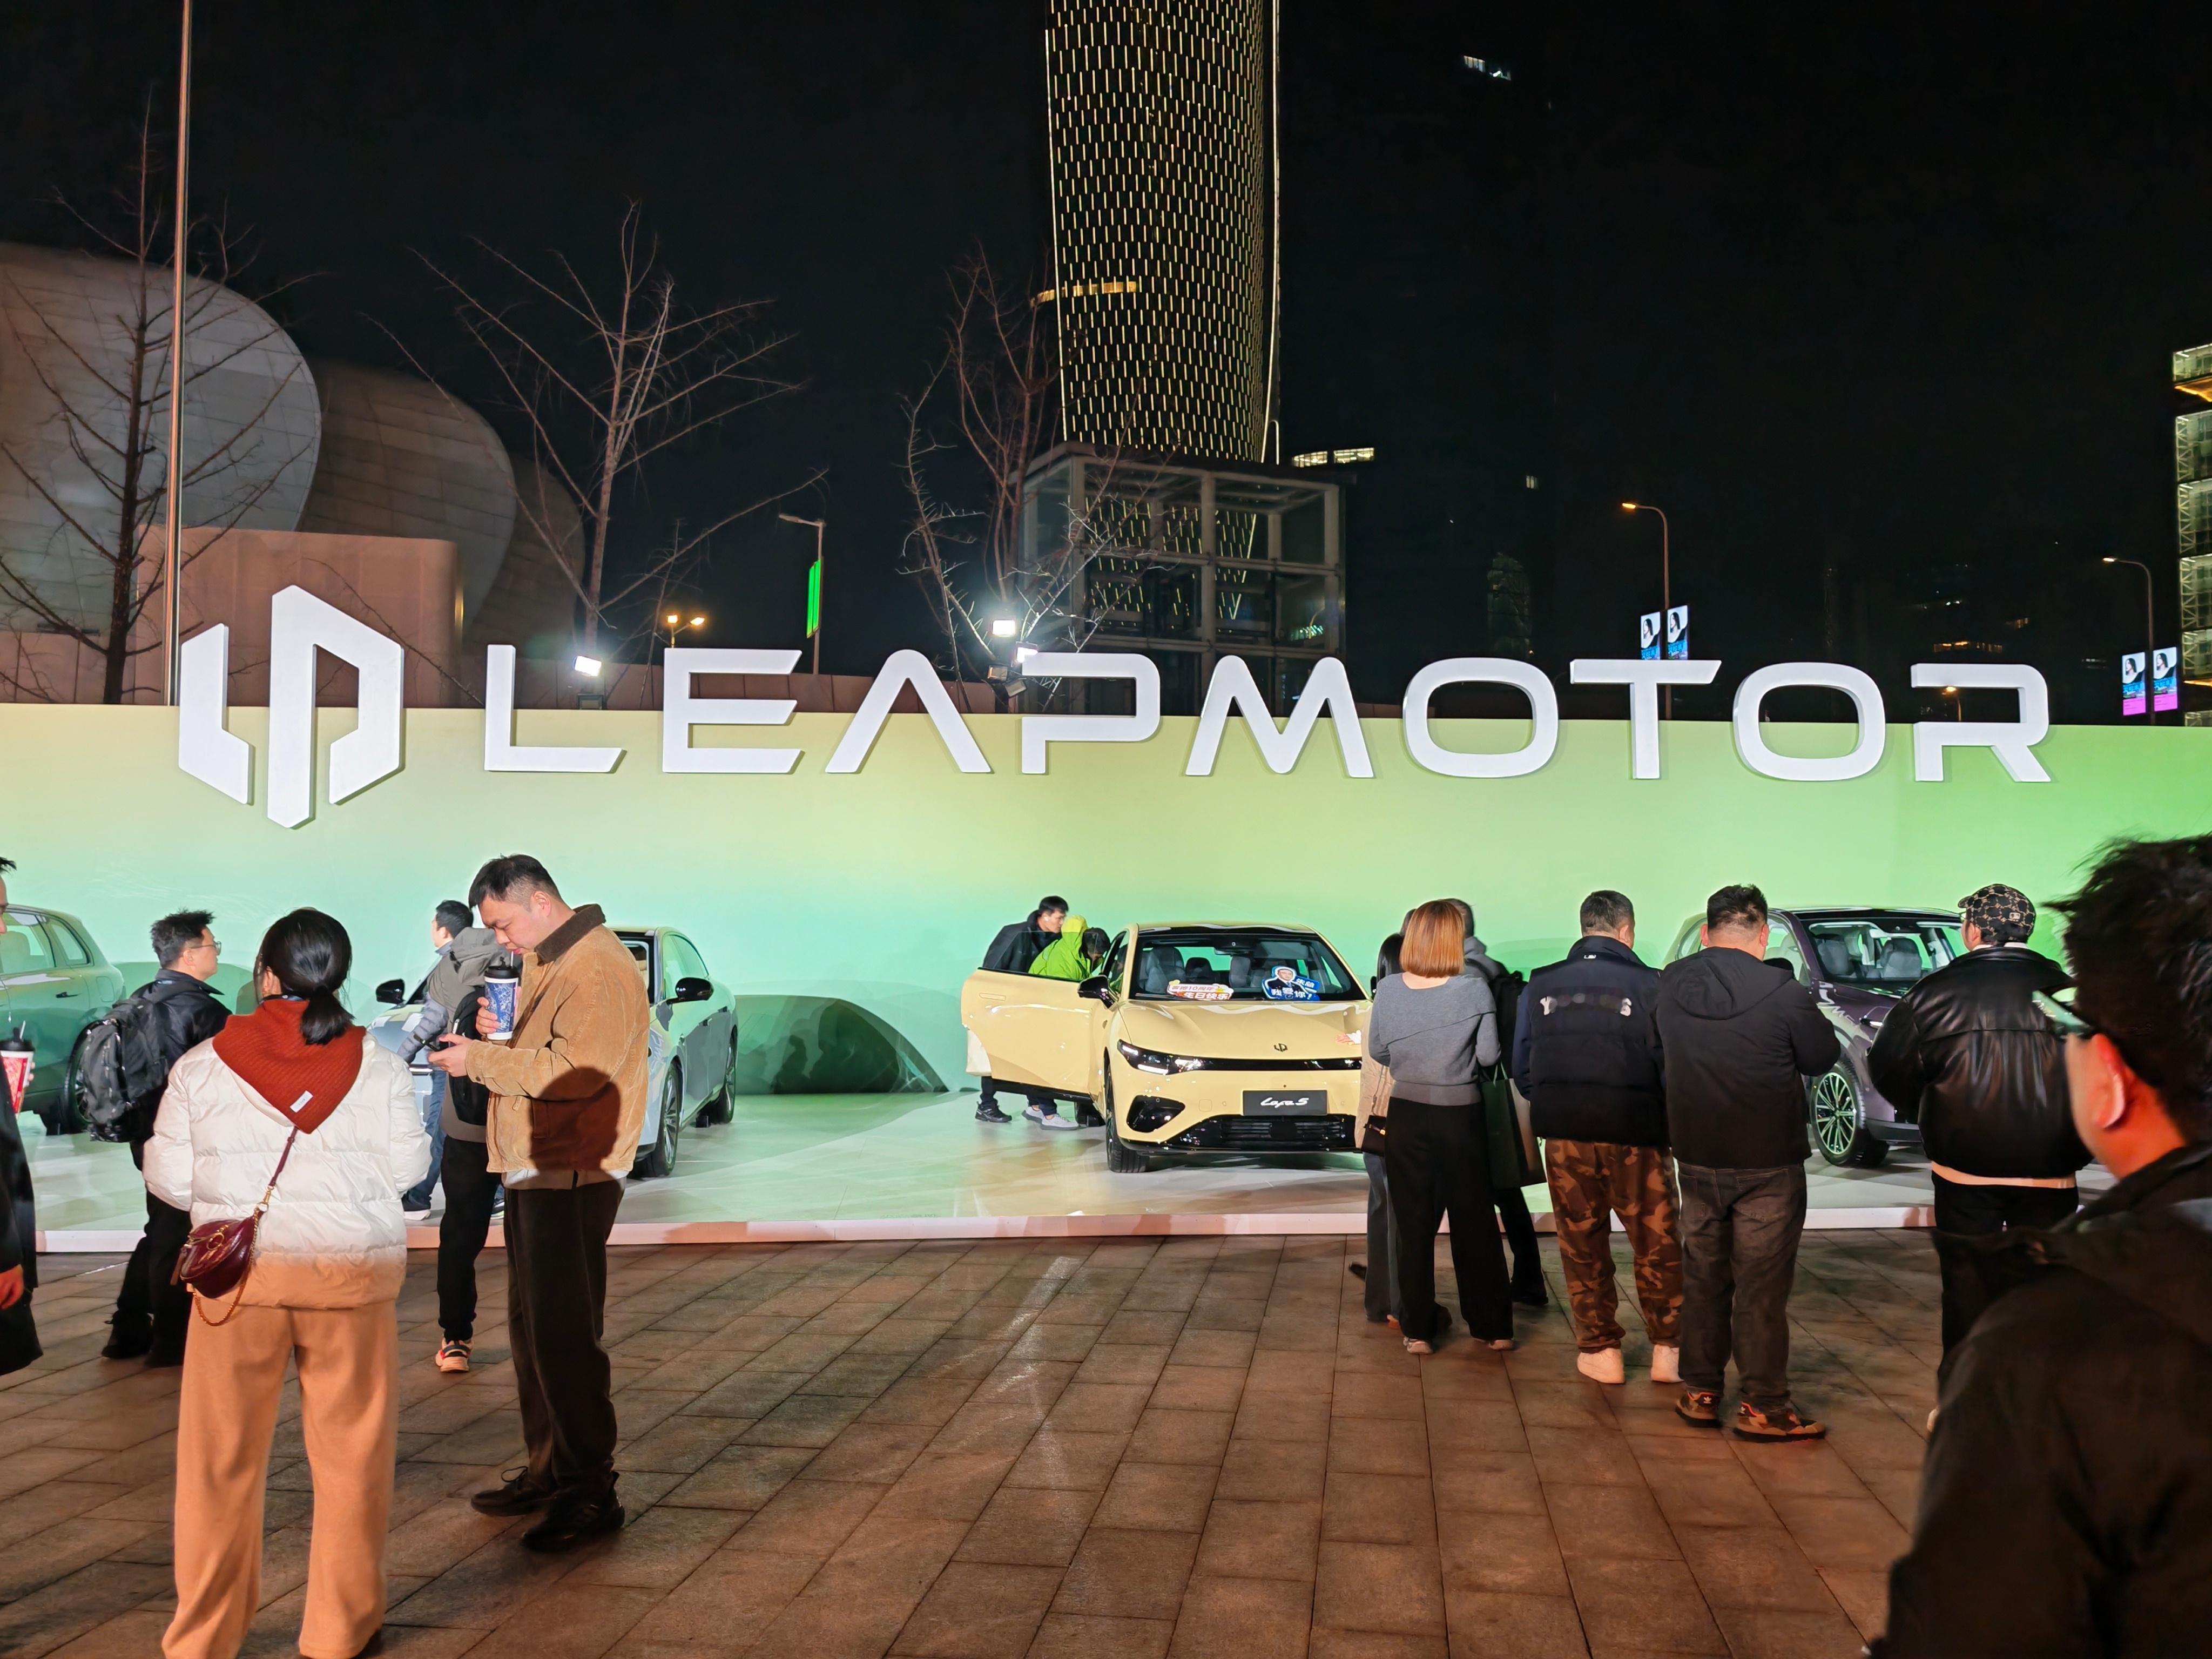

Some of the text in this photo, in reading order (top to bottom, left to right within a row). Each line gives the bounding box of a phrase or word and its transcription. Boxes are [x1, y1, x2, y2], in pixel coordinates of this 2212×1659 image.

[484, 644, 2051, 783] LEAPMOTOR
[1183, 992, 1229, 1000] 生日快乐
